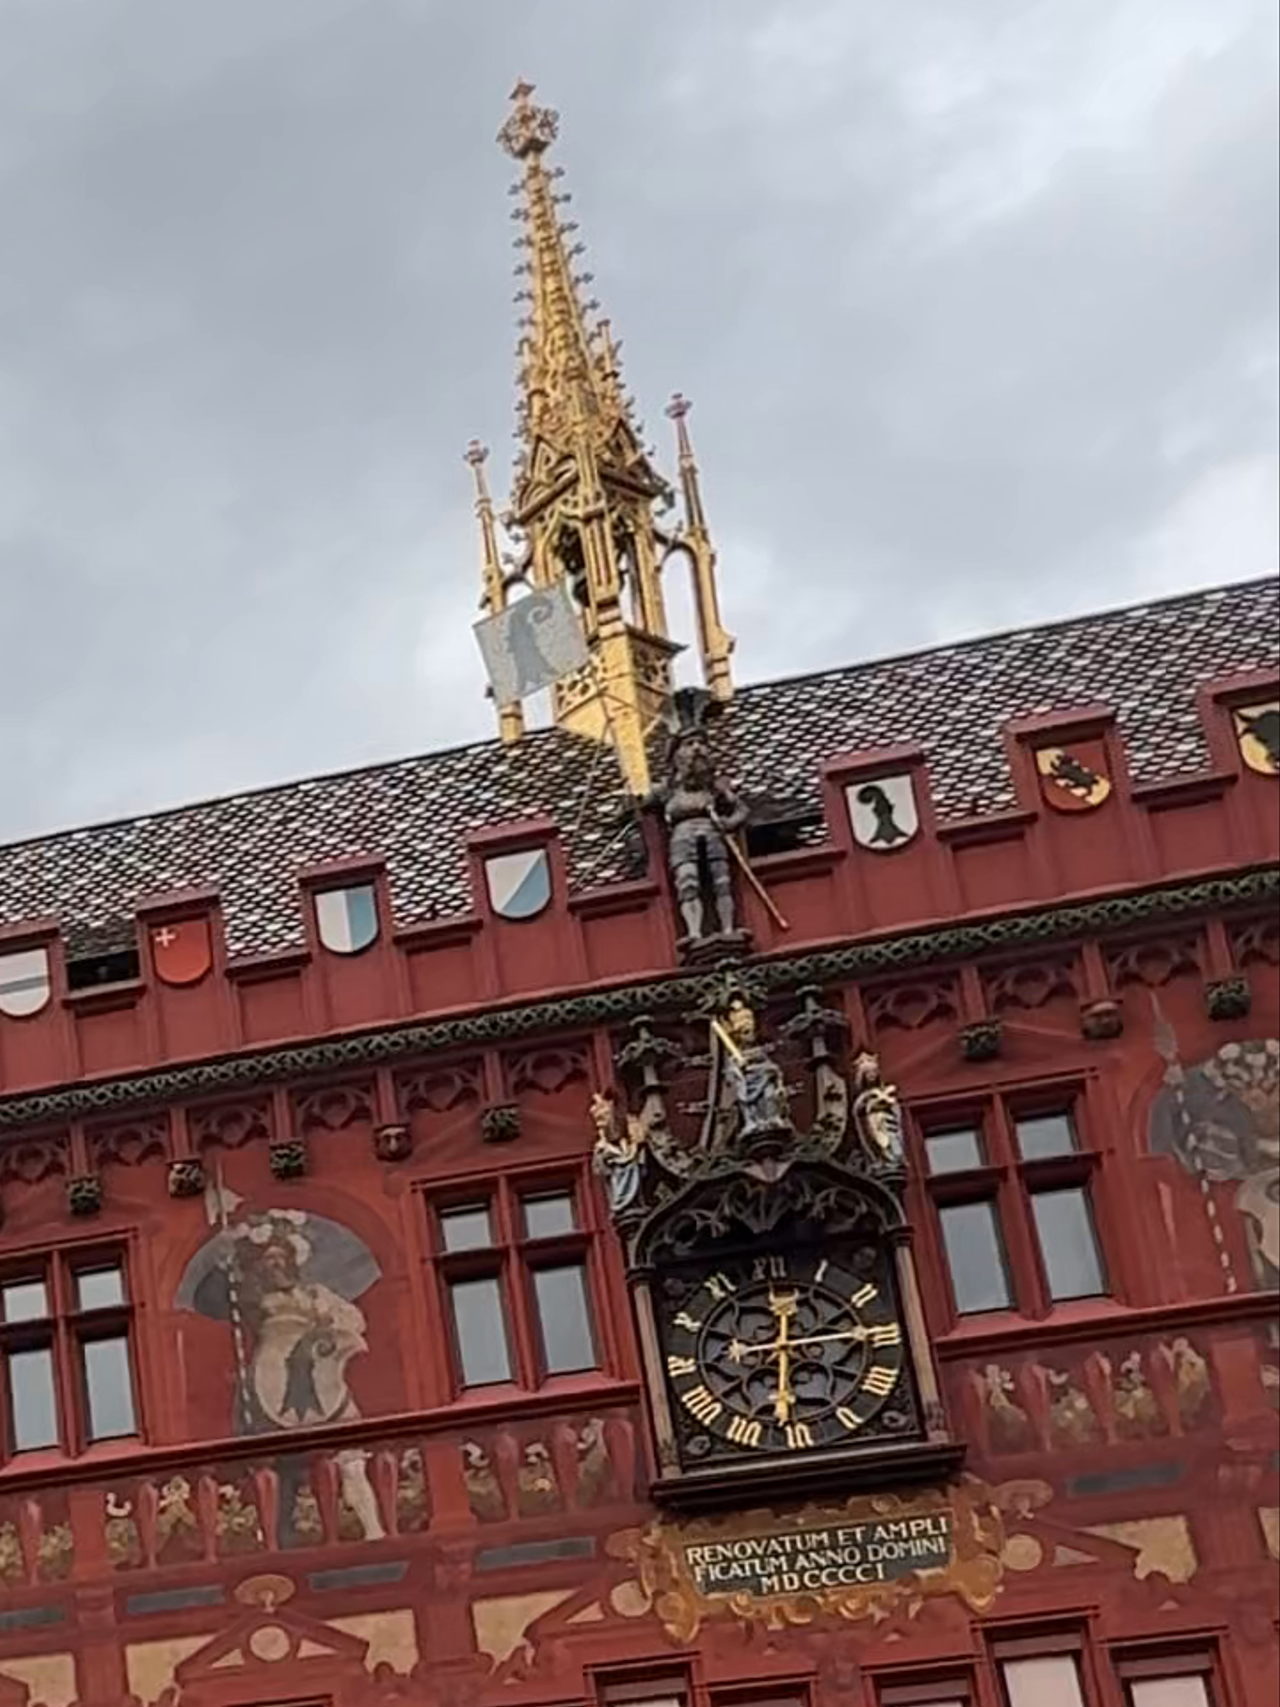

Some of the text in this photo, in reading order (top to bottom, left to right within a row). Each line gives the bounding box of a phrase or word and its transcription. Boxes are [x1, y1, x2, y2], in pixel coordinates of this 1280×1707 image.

[851, 1283, 878, 1308] II
[686, 1517, 947, 1566] RENOVATUM ET AMPLI
[693, 1536, 946, 1583] FICATUM ANNO DOMINI
[761, 1563, 884, 1594] MDCCCCI
